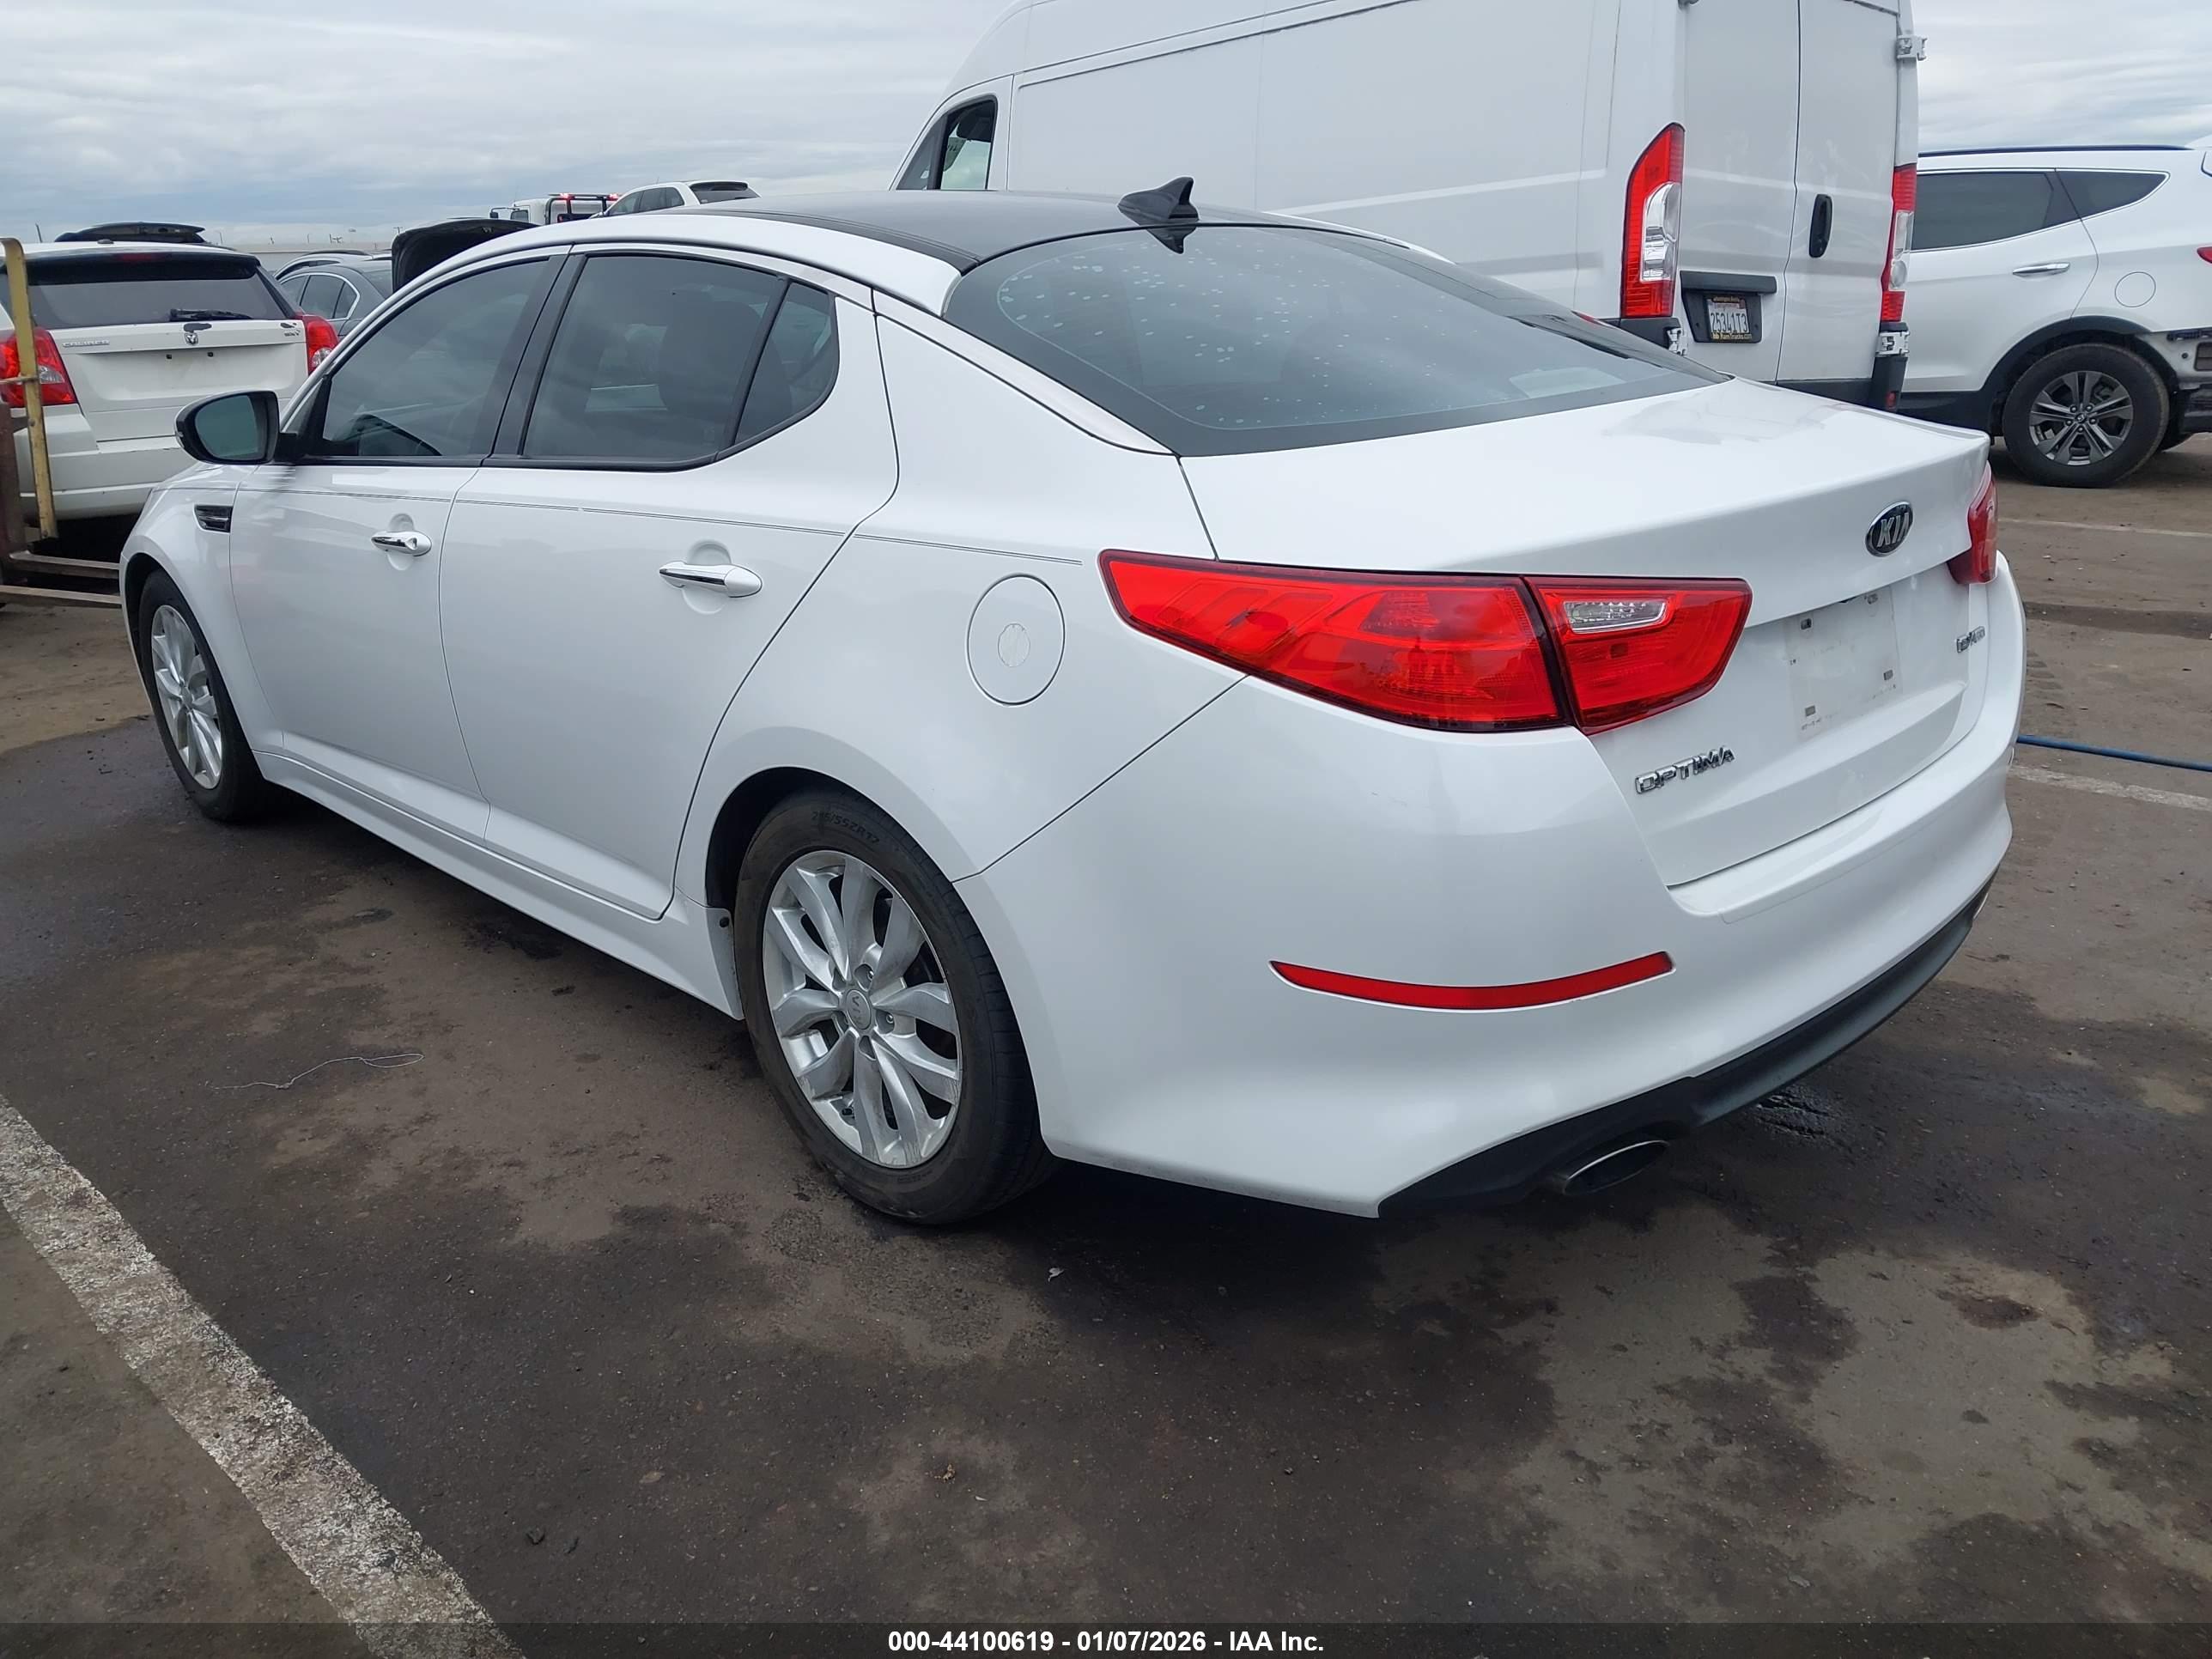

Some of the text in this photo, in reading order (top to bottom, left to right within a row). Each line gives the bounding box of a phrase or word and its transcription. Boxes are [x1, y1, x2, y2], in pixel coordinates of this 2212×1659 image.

[1710, 312, 1748, 332] 25341T3
[1876, 513, 1910, 547] KIA
[1634, 745, 1735, 794] OPTIMA
